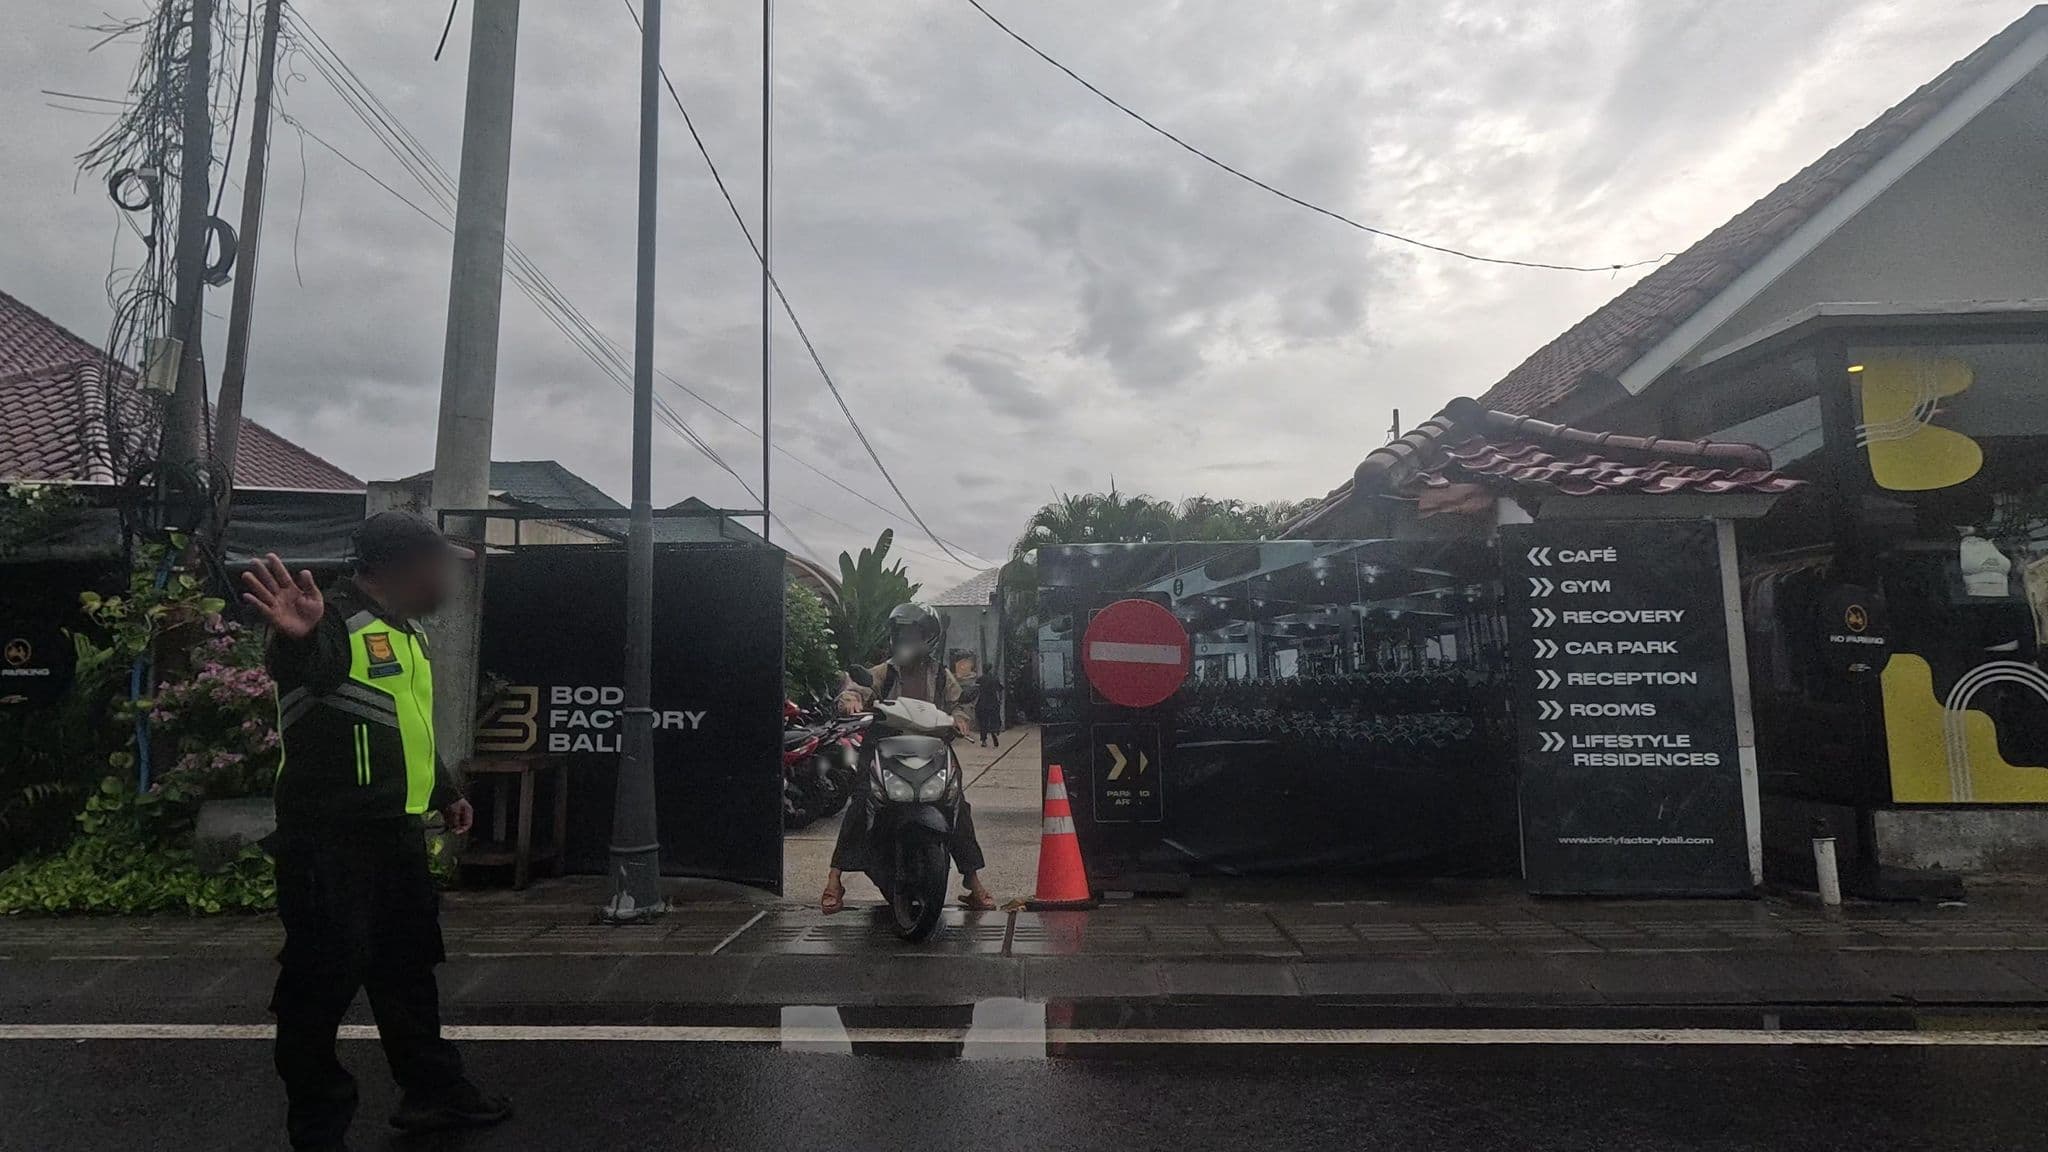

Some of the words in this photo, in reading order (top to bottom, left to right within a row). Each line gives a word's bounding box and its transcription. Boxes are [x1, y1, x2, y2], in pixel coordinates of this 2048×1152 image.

[1558, 546, 1617, 563] CAFÉ
[1560, 579, 1611, 594] GYM
[1562, 609, 1685, 624] RECOVERY
[1830, 635, 1845, 643] NO
[1564, 641, 1614, 655] CAR
[1617, 640, 1679, 654] PARK
[1567, 671, 1698, 686] RECEPTION
[550, 686, 625, 705] BOD
[1569, 703, 1657, 717] ROOMS
[548, 733, 622, 753] BALI
[1572, 734, 1691, 748] LIFESTYLE
[1573, 752, 1721, 767] RESIDENCES
